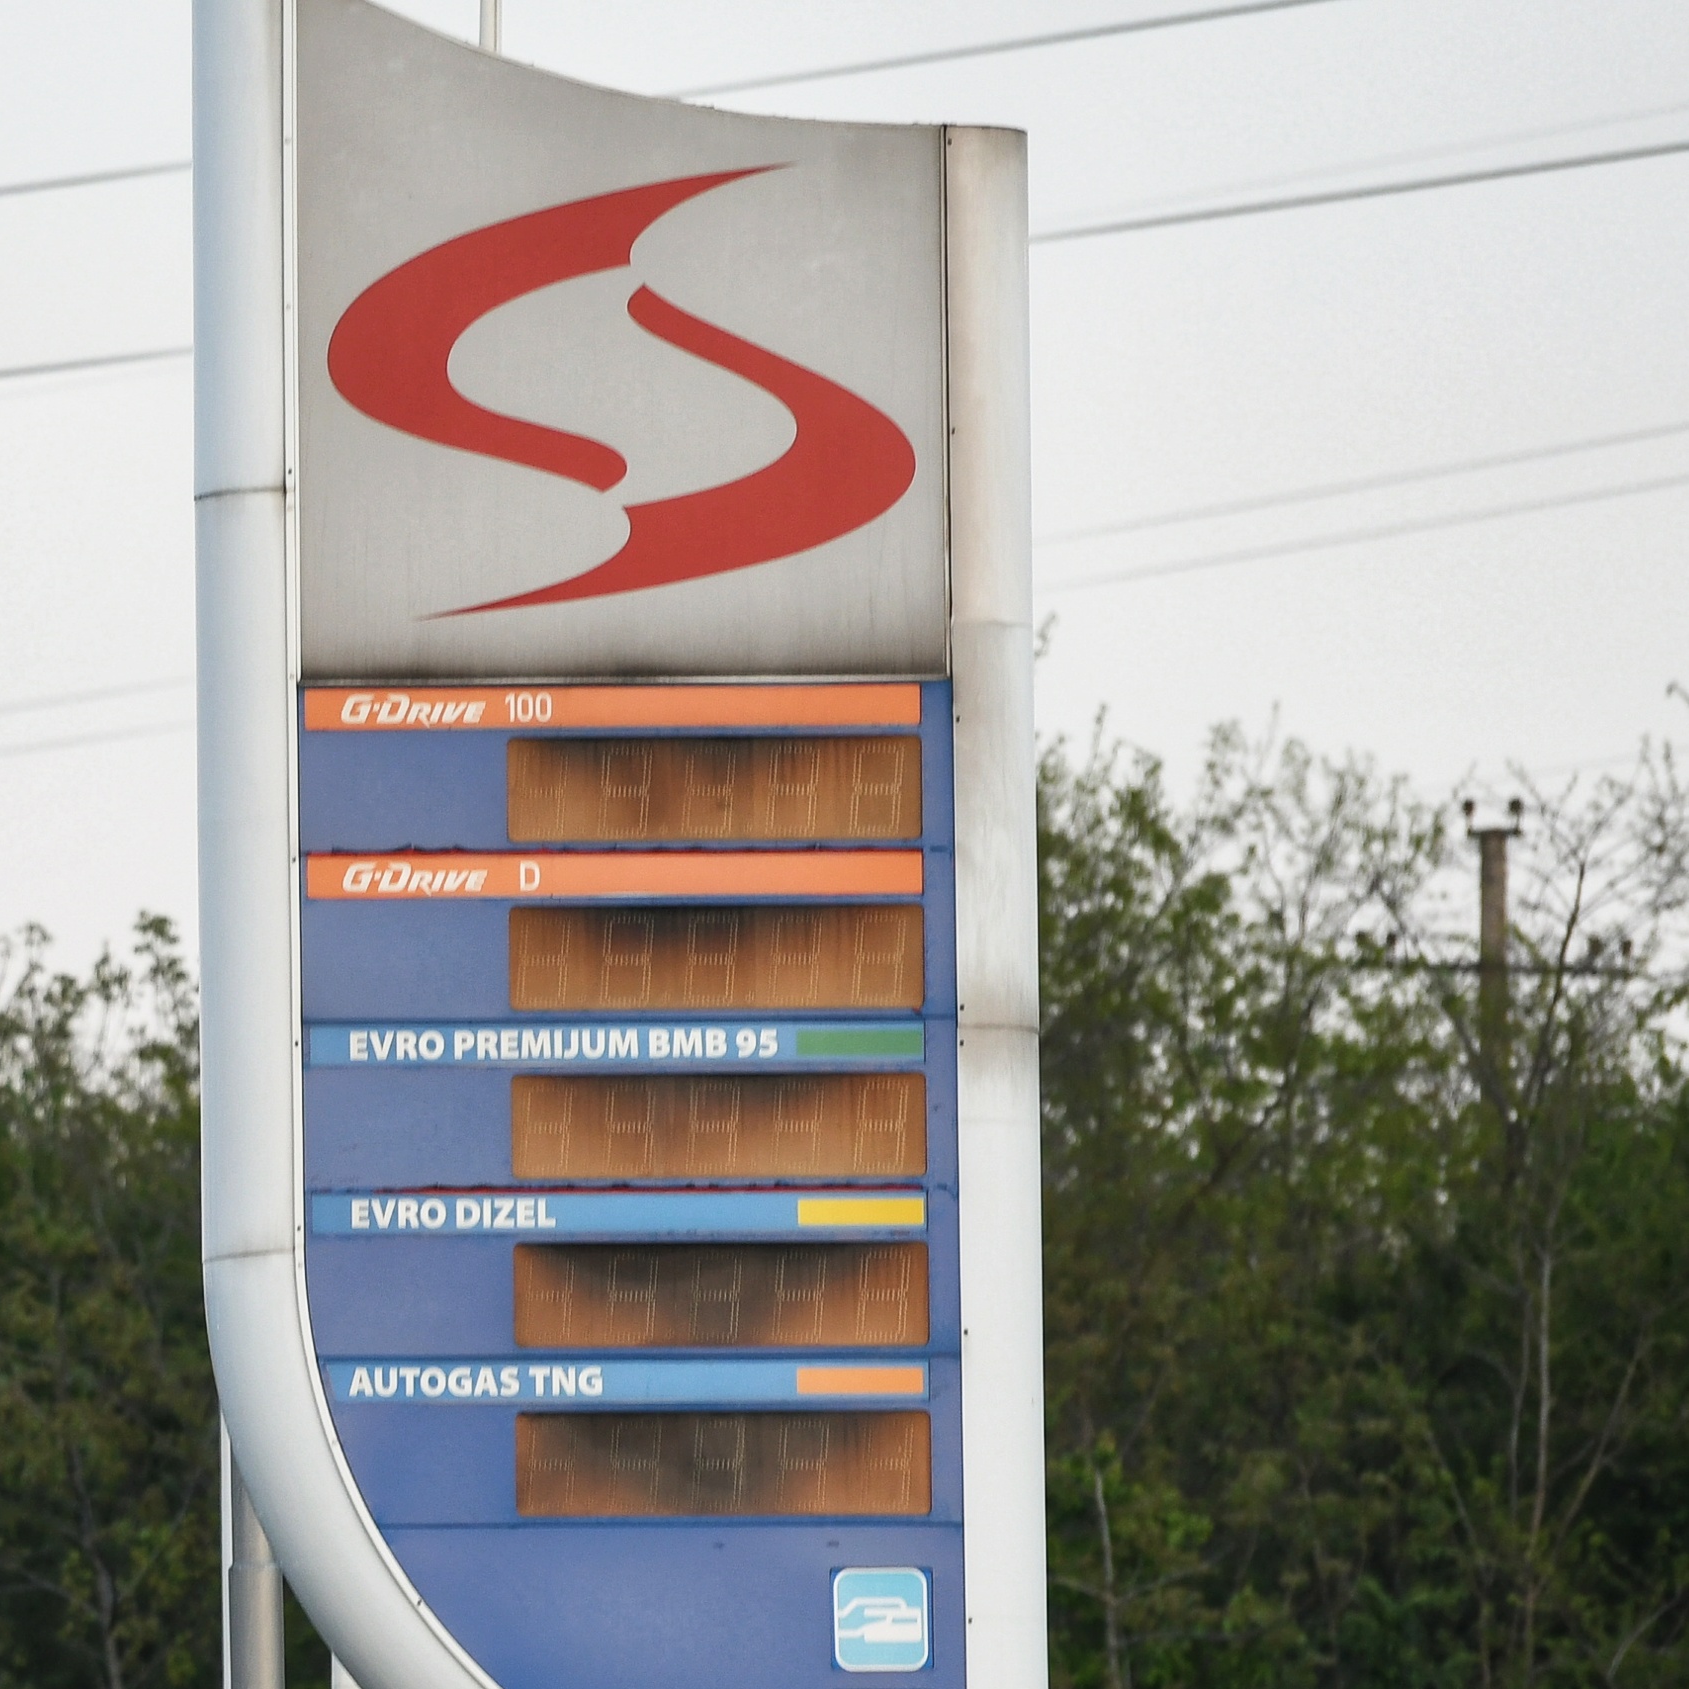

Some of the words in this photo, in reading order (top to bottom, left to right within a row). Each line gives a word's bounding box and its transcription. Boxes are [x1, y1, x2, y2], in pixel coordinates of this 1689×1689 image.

[505, 691, 553, 723] 100
[519, 860, 541, 892] D
[349, 1030, 445, 1061] EVRO
[453, 1029, 639, 1060] PREMIJUM
[648, 1029, 727, 1059] BMB
[735, 1028, 779, 1059] 95
[351, 1198, 447, 1230] EVRO
[455, 1198, 557, 1230] DIZEL
[348, 1366, 520, 1398] AUTOGAS
[528, 1366, 603, 1397] TNG
